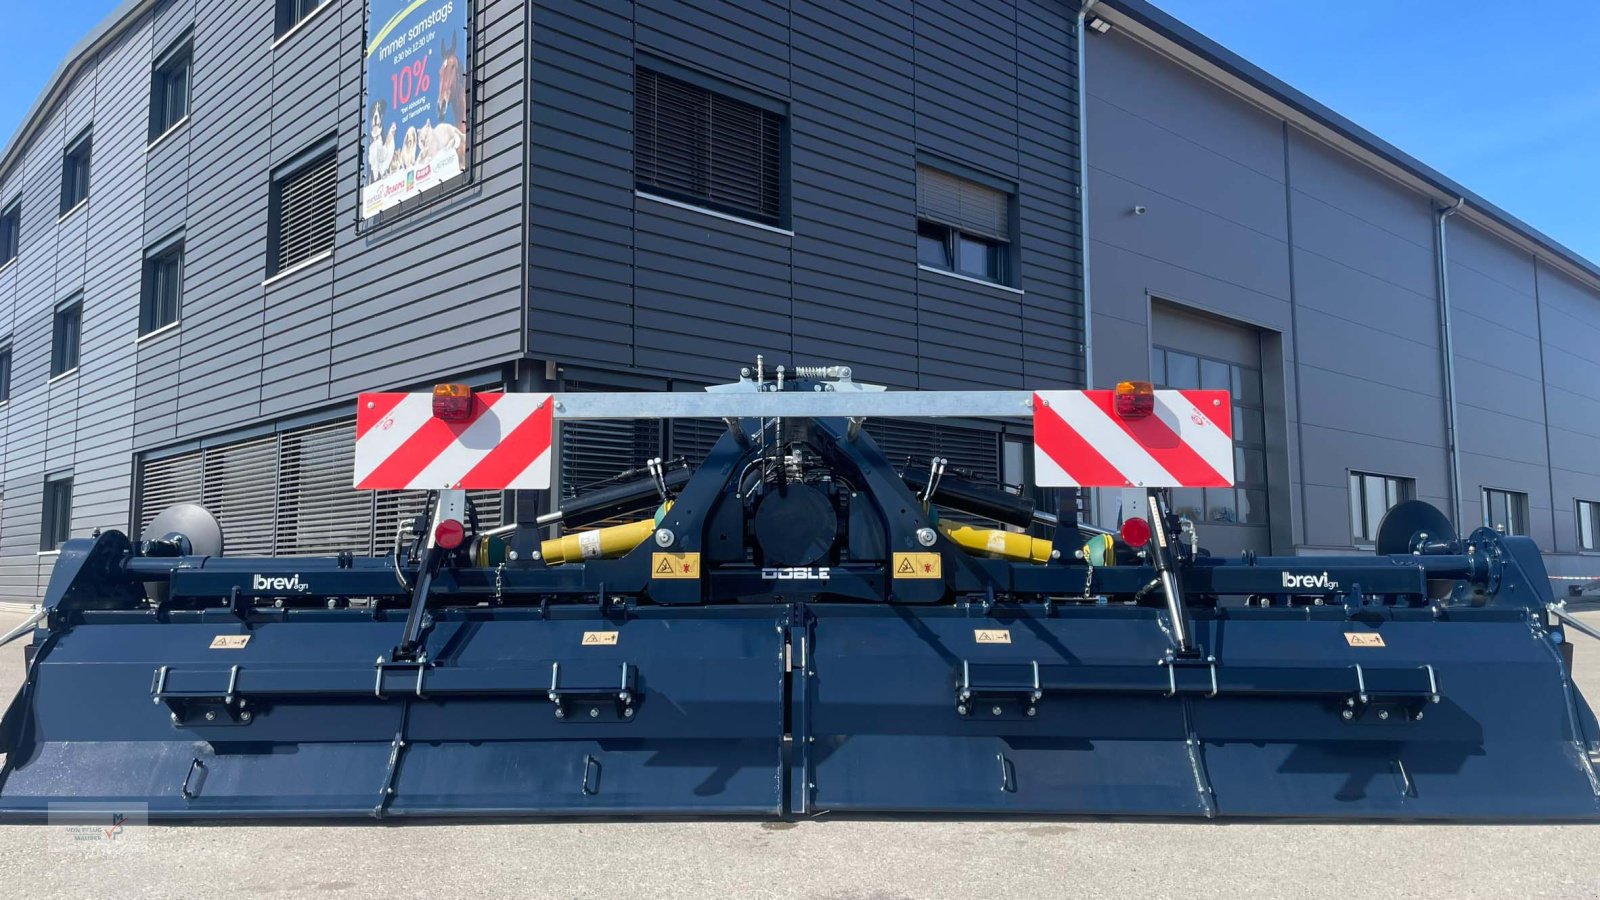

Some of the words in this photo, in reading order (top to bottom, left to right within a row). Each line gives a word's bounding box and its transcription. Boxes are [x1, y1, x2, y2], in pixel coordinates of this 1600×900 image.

[380, 32, 407, 62] immer
[408, 1, 453, 41] samstags
[426, 31, 436, 44] Uhr
[761, 567, 830, 580] DOBLE
